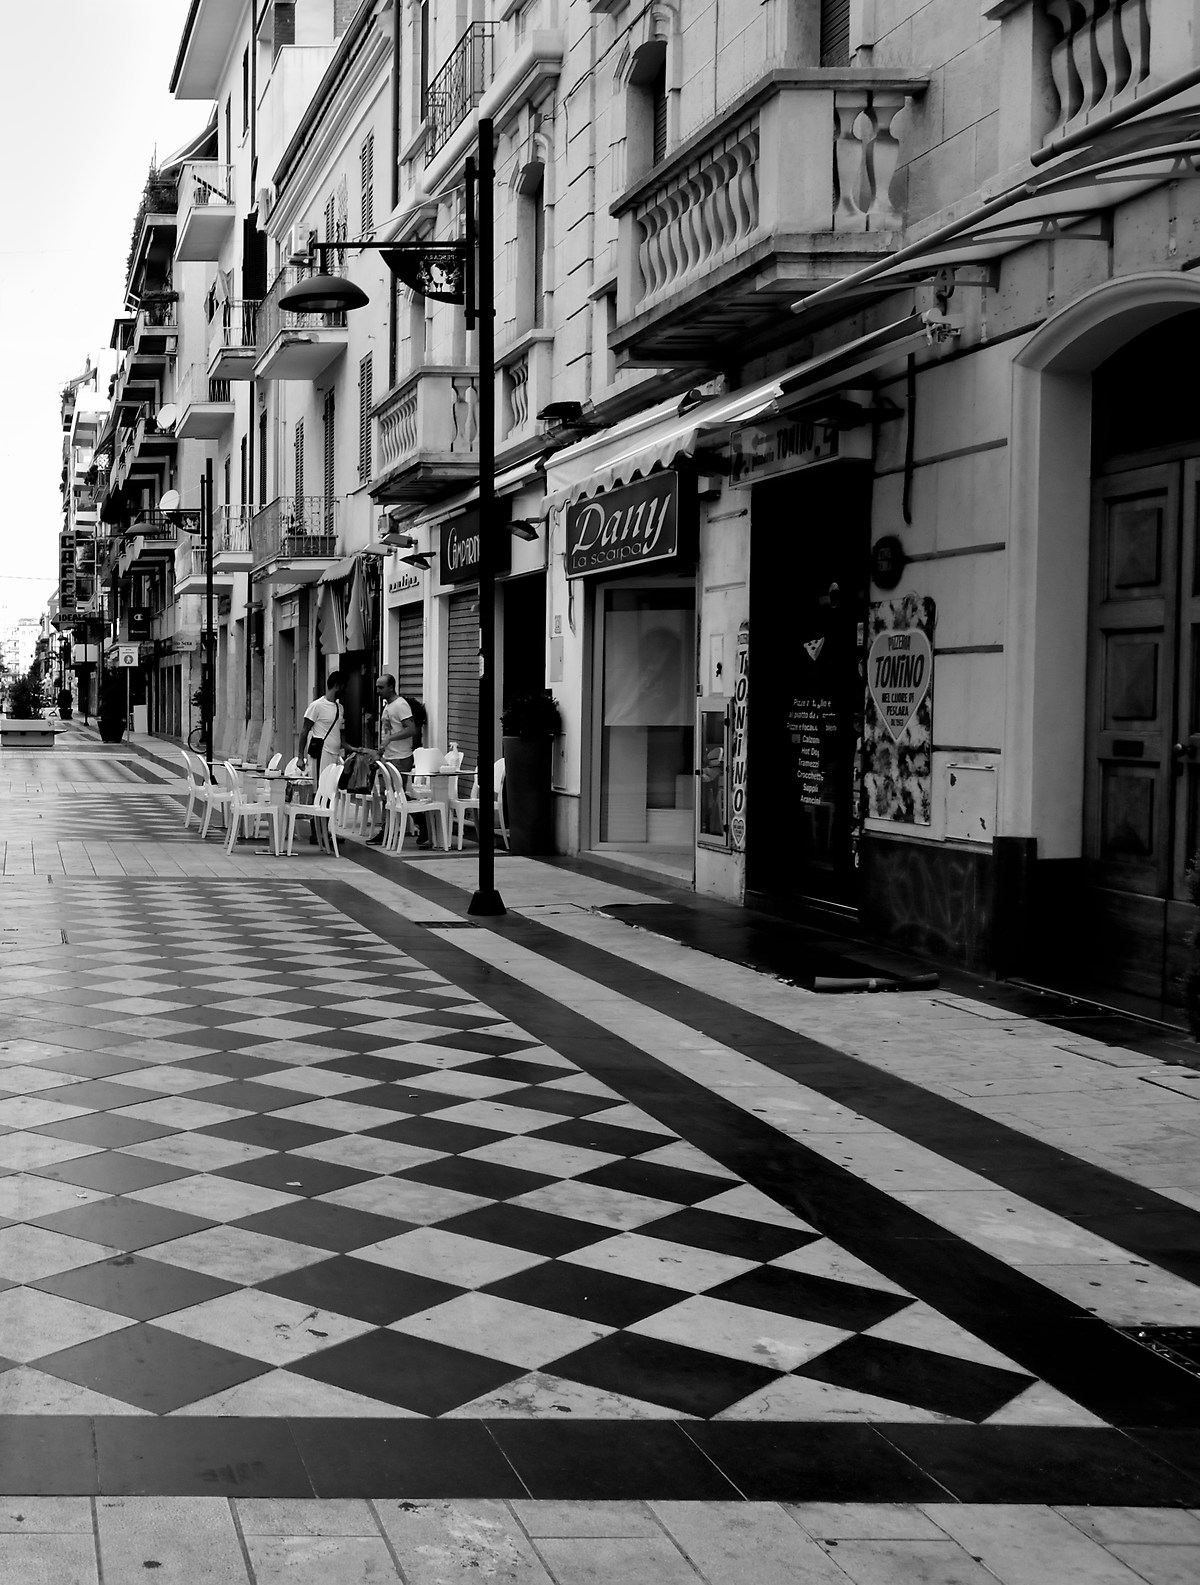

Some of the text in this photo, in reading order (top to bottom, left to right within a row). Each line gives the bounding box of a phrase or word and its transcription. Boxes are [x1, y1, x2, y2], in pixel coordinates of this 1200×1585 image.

[571, 493, 671, 555] Dany
[572, 542, 642, 569] La scarpa
[61, 535, 75, 608] CAFFE
[882, 692, 890, 703] NEL
[891, 692, 908, 703] CUORE
[886, 705, 909, 716] PESCARA
